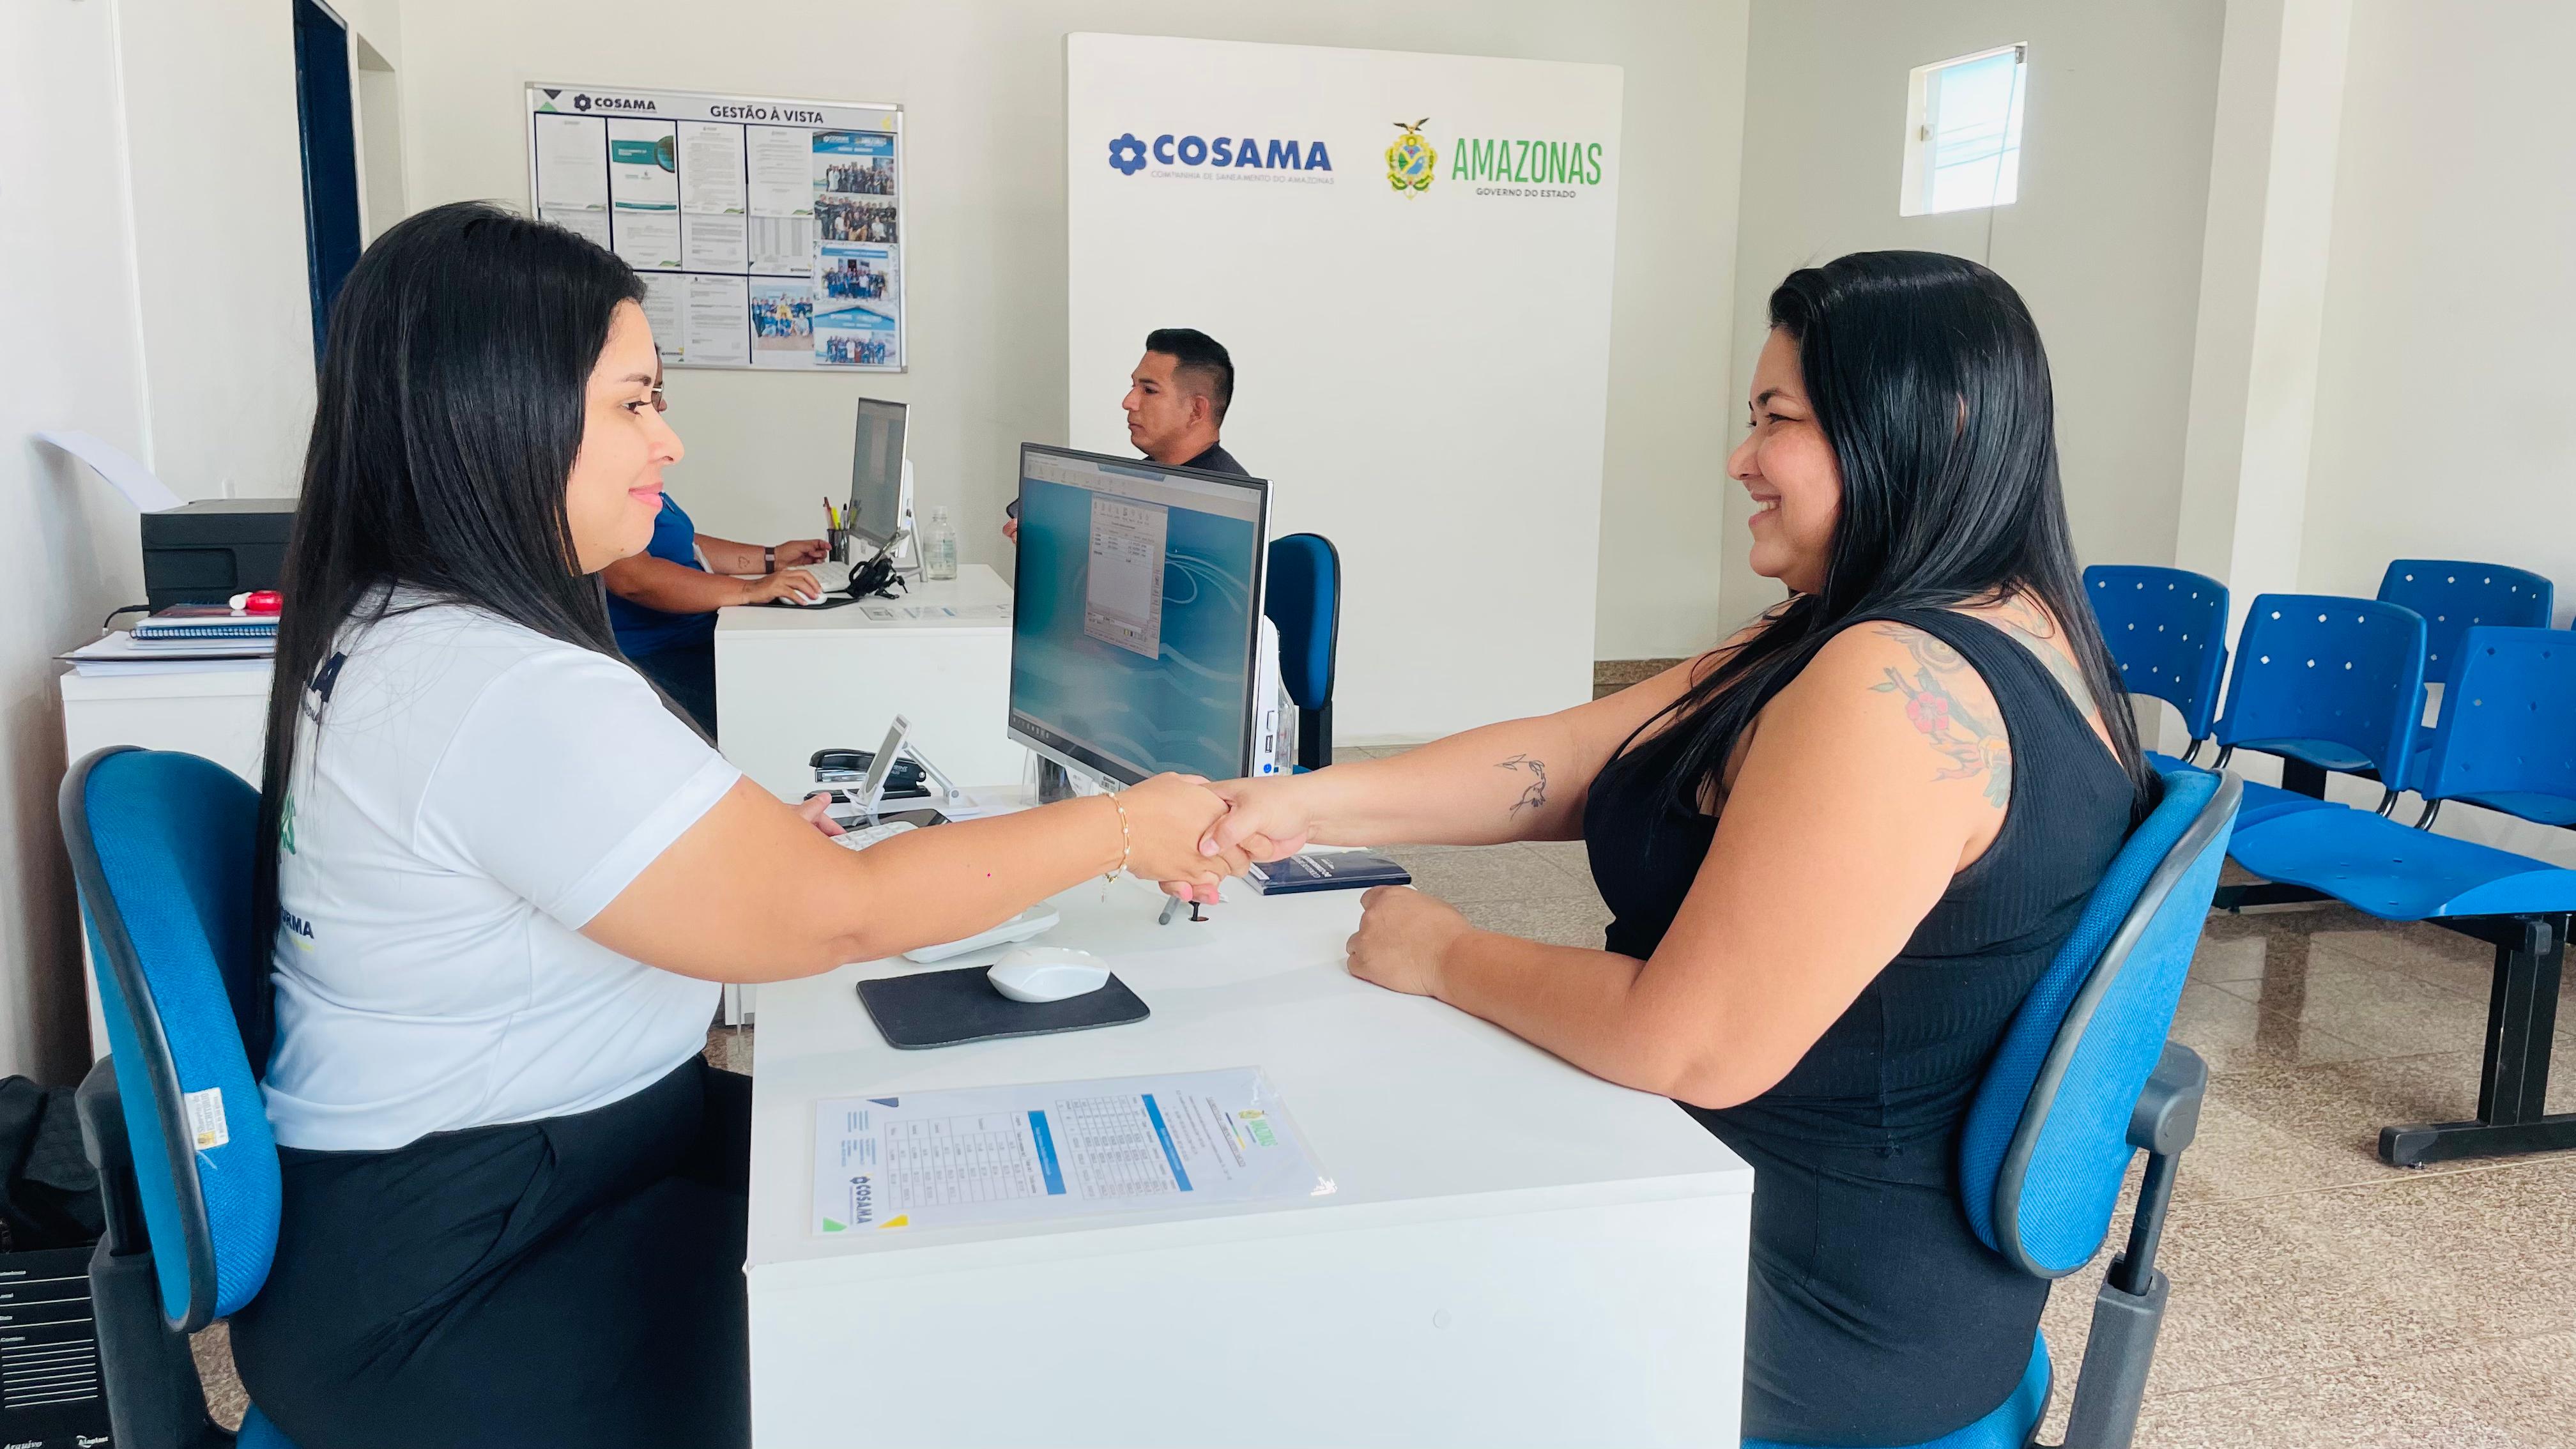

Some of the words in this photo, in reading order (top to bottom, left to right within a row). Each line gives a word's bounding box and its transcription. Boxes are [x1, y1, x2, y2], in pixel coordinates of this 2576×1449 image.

[595, 98, 656, 110] COSAMA
[710, 105, 767, 119] GESTÃO
[770, 107, 779, 121] À
[784, 110, 824, 123] VISTA
[1153, 134, 1332, 171] COSAMA
[1452, 138, 1602, 185] AMAZONAS
[1151, 171, 1200, 180] COMPANHIA
[1216, 173, 1271, 183] SANEAMENTO
[1288, 176, 1335, 185] AMAZONAS
[1476, 188, 1522, 197] GOVERNO
[1524, 189, 1538, 197] DO
[1540, 190, 1576, 198] ESTADO
[855, 1184, 873, 1224] COSAMA
